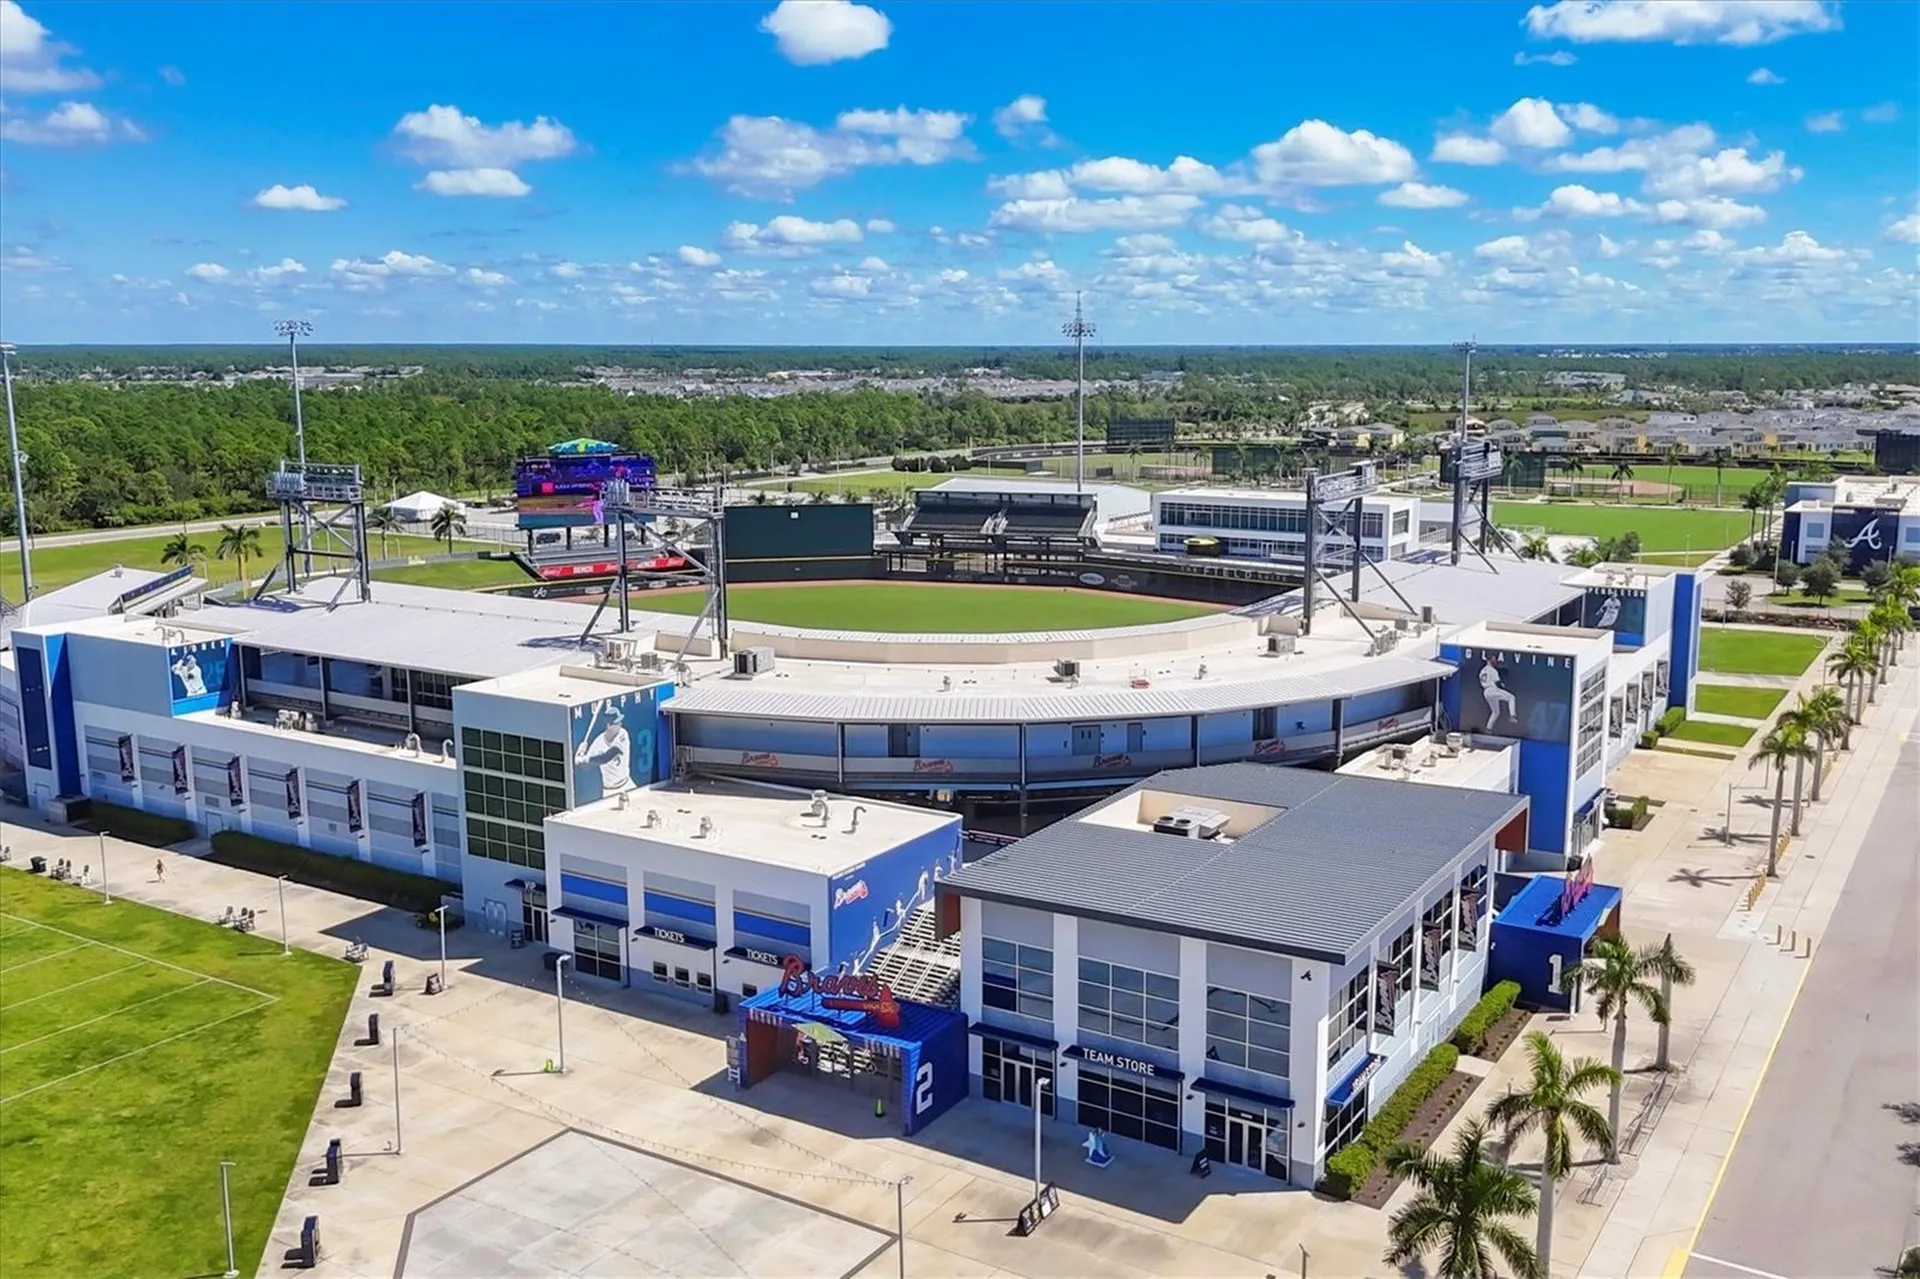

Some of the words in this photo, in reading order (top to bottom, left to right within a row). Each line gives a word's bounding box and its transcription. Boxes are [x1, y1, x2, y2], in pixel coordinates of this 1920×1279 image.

[1843, 518, 1882, 550] A
[1465, 648, 1573, 669] GLAVINE
[575, 688, 655, 719] MURPHY
[637, 729, 653, 773] 3
[654, 927, 685, 944] TICKETS
[746, 948, 778, 965] TICKETS
[779, 955, 882, 999] Braves
[1547, 953, 1564, 994] 1
[1082, 1047, 1114, 1066] TEAM
[1116, 1056, 1155, 1076] STORE
[916, 1061, 934, 1115] 2
